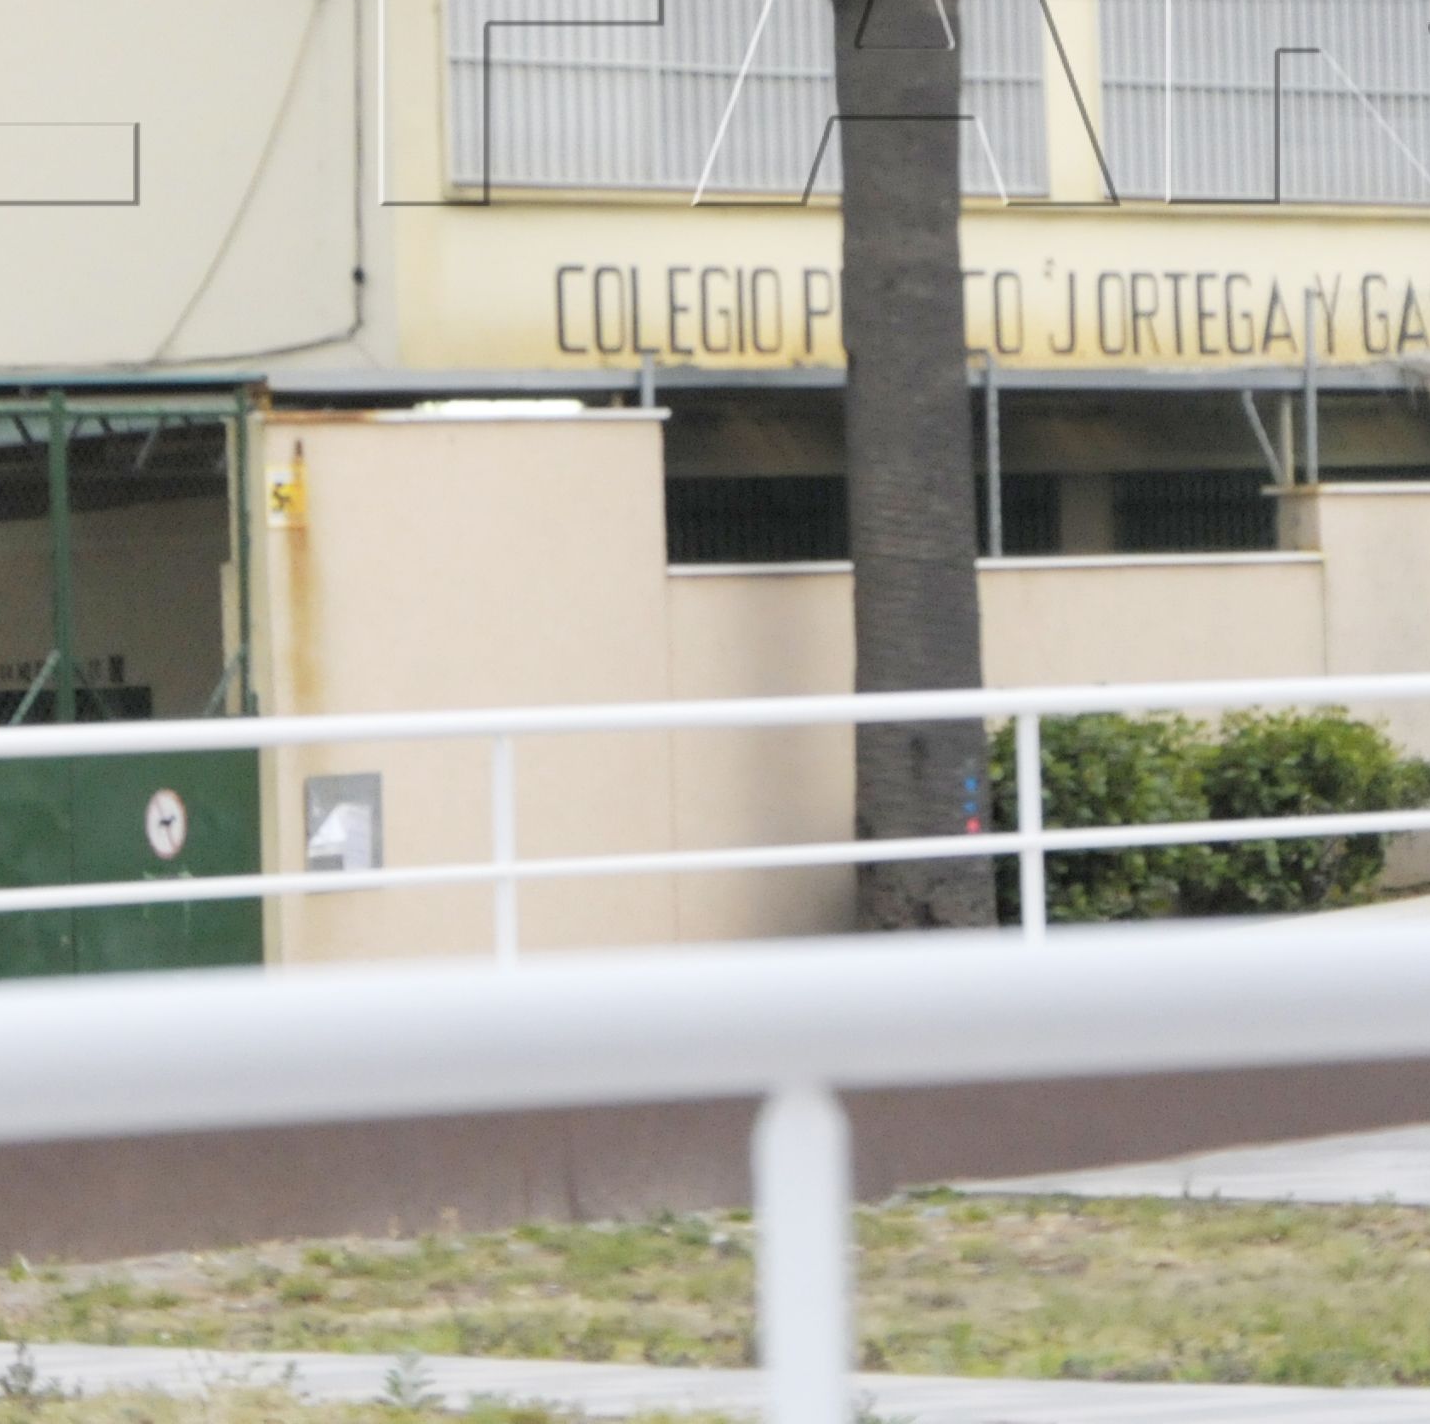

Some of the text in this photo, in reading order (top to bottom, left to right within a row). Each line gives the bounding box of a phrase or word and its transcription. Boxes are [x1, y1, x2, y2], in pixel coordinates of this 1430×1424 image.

[555, 265, 784, 356] COLEGIO
[1096, 271, 1299, 356] ORTEGA
[1313, 271, 1342, 356] Y
